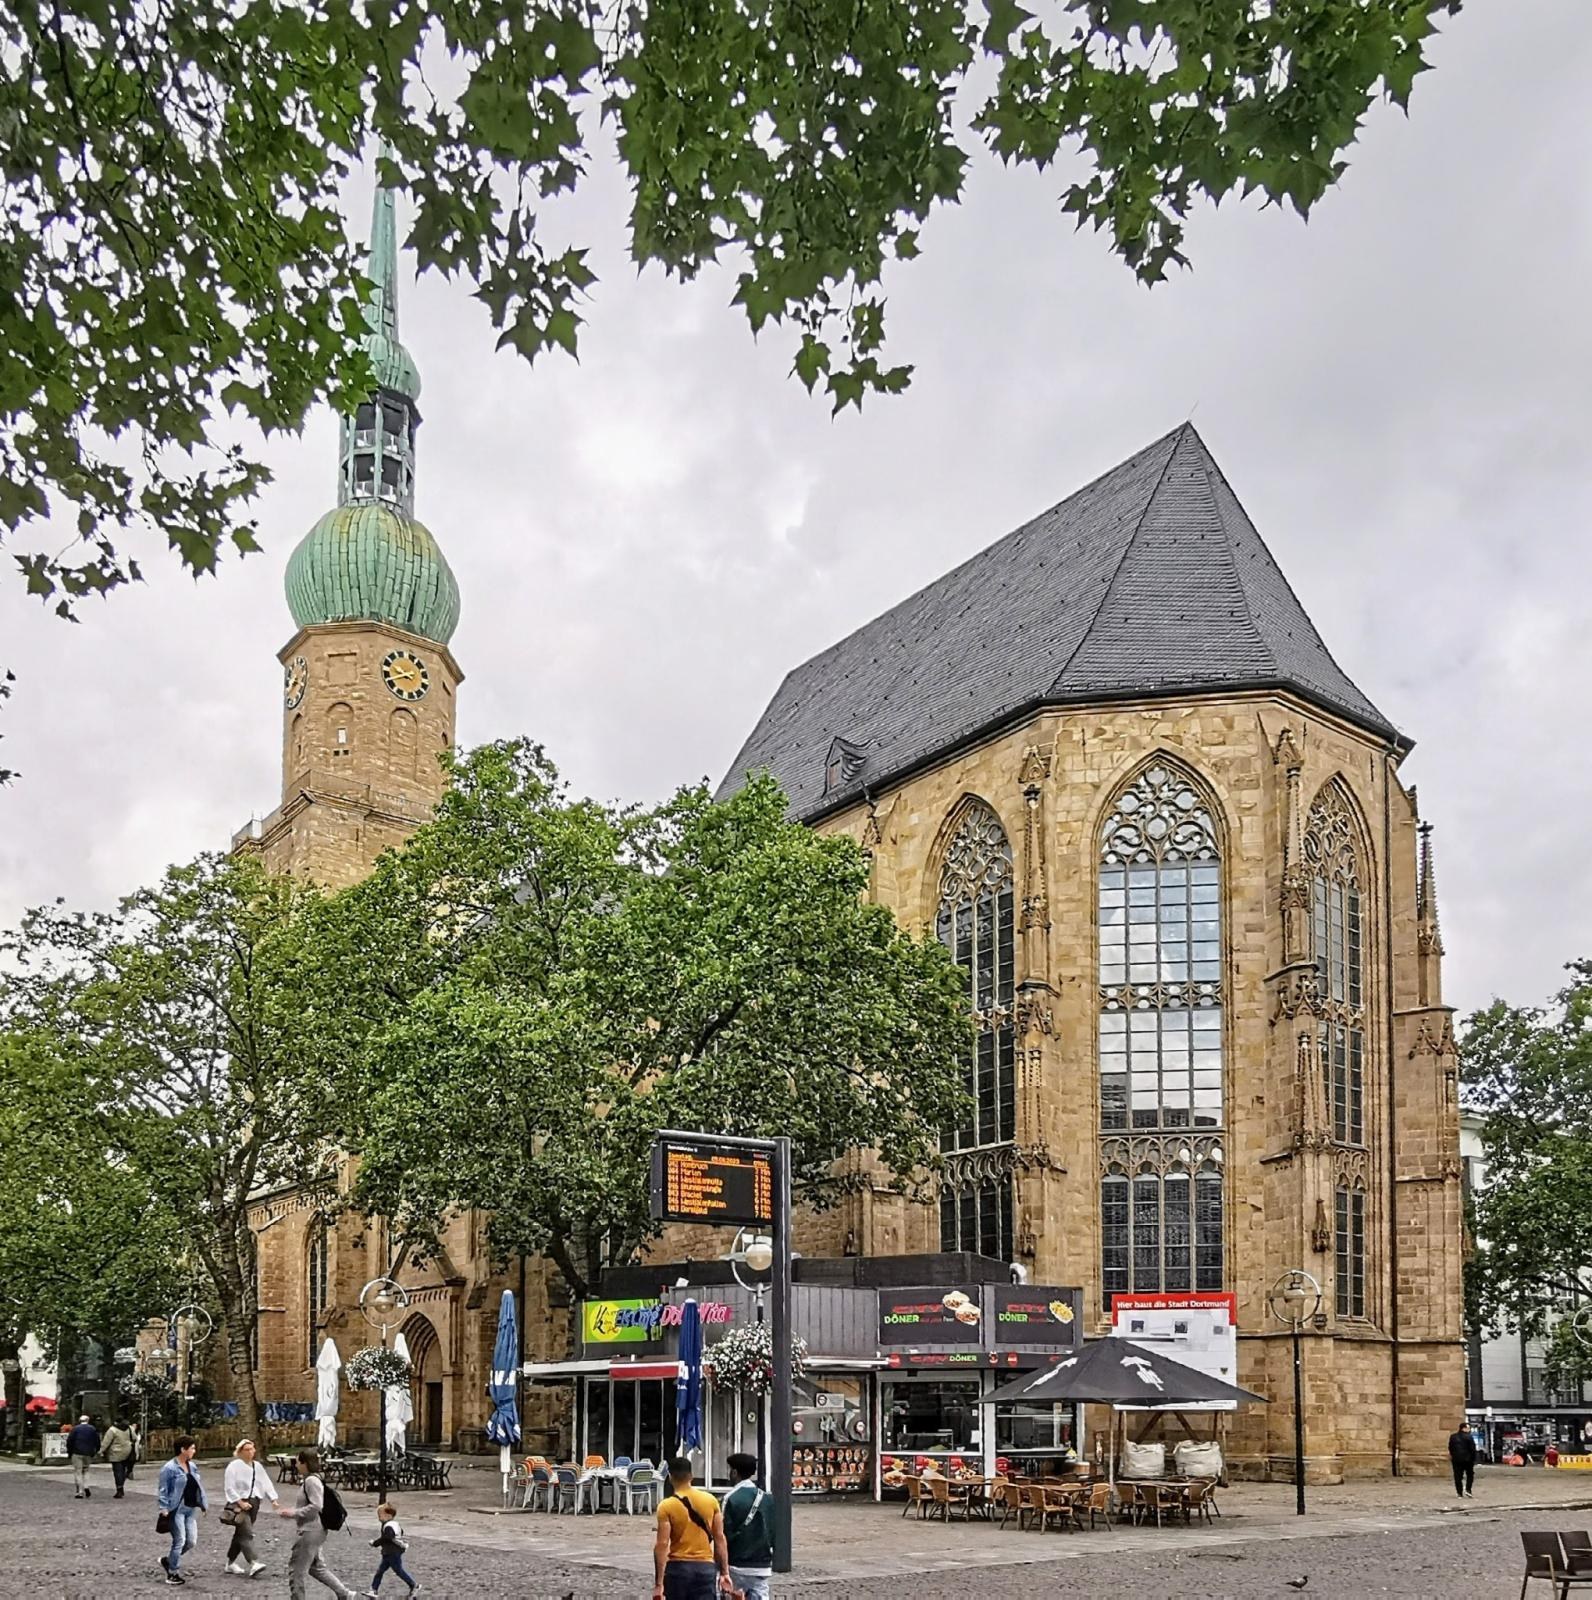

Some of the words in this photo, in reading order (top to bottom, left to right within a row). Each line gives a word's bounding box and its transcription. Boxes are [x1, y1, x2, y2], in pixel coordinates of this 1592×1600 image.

[1168, 1300, 1188, 1308] Stadt
[698, 1303, 729, 1324] Vita
[998, 1312, 1028, 1323] DÖNER
[884, 1314, 920, 1324] DÖNER
[949, 1354, 977, 1362] DÖNER
